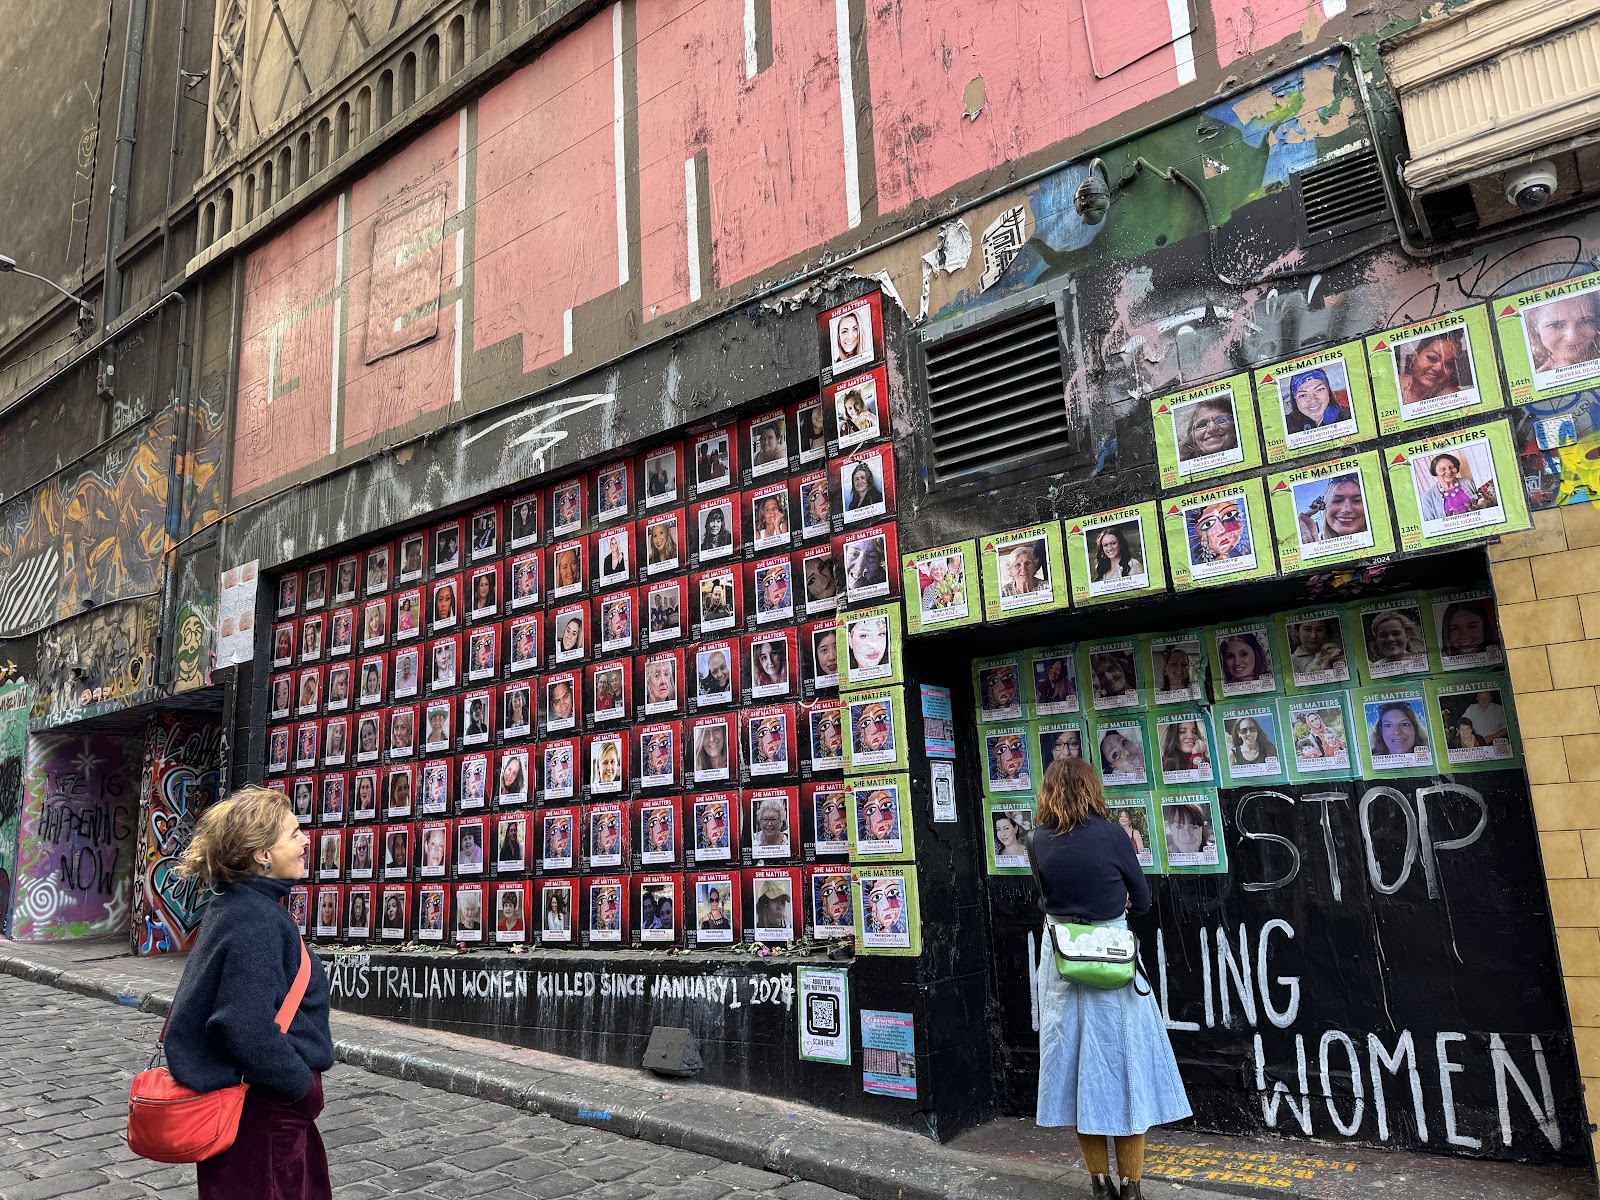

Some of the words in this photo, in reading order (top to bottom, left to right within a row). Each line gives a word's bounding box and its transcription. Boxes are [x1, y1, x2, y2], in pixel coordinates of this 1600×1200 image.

[1518, 293, 1541, 306] SHE
[1545, 279, 1600, 302] MATTERS
[832, 310, 842, 318] SHE
[842, 299, 868, 314] MATTERS
[1389, 331, 1409, 342] SHE
[1412, 314, 1464, 336] MATTERS
[1275, 364, 1294, 376] SHE
[1296, 350, 1343, 369] MATTERS
[1556, 360, 1599, 373] Remembering
[1510, 378, 1530, 388] 14th
[1170, 394, 1186, 406] SHE
[1190, 382, 1232, 400] MATTERS
[1420, 393, 1458, 406] Remembering
[1514, 396, 1534, 404] 2025
[1381, 409, 1398, 418] 12th
[1384, 426, 1400, 434] 2025
[1408, 443, 1429, 455] SHE
[1432, 429, 1487, 450] MATTERS
[1289, 472, 1308, 482] SHE
[1311, 459, 1359, 478] MATTERS
[754, 490, 763, 498] SHE
[764, 484, 786, 494] MATTERS
[1181, 497, 1198, 507] SHE
[1201, 486, 1244, 502] MATTERS
[1082, 518, 1098, 527] SHE
[1100, 508, 1140, 523] MATTERS
[1442, 510, 1481, 522] Remembering
[856, 528, 882, 540] MATTERS
[1401, 524, 1418, 534] 13th
[996, 536, 1008, 544] SHE
[1012, 528, 1046, 541] MATTERS
[1318, 536, 1352, 546] Remembering
[916, 554, 928, 562] SHE
[930, 546, 962, 558] MATTERS
[1282, 548, 1298, 556] 11th
[767, 556, 788, 566] MATTERS
[1372, 556, 1390, 564] 2024
[1284, 564, 1300, 572] 2025
[1360, 604, 1376, 612] SHE
[1378, 598, 1416, 610] MATTERS
[860, 608, 888, 618] MATTERS
[1286, 616, 1300, 624] SHE
[1302, 609, 1338, 622] MATTERS
[1216, 628, 1230, 636] SHE
[1231, 622, 1265, 634] MATTERS
[1166, 634, 1198, 643] MATTERS
[1438, 686, 1454, 694] SHE
[1456, 680, 1498, 692] MATTERS
[862, 690, 891, 700] MATTERS
[1364, 694, 1380, 702] SHE
[1382, 690, 1420, 700] MATTERS
[1304, 699, 1340, 710] MATTERS
[1156, 716, 1169, 724] SHE
[1170, 712, 1202, 722] MATTERS
[1223, 710, 1236, 718] SHE
[1238, 706, 1271, 716] MATTERS
[996, 726, 1024, 736] MATTERS
[1039, 724, 1051, 732] SHE
[1052, 722, 1080, 731] MATTERS
[1097, 722, 1108, 730] SHE
[1110, 720, 1140, 728] MATTERS
[100, 773, 122, 798] IS
[866, 778, 897, 786] MATTERS
[1120, 797, 1145, 805] MATTERS
[1161, 796, 1174, 804] SHE
[1176, 794, 1208, 803] MATTERS
[1002, 802, 1030, 810] MATTERS
[38, 802, 130, 847] HAPPENING
[1235, 783, 1488, 902] STOP
[61, 845, 120, 894] NOW
[330, 965, 456, 998] AUSTRALIAN
[462, 968, 528, 998] WOMEN
[537, 970, 595, 998] KILLED
[601, 972, 646, 998] SINCE
[650, 974, 729, 1004] JANUARY
[730, 980, 742, 1009] 1
[812, 1038, 824, 1046] SCAN
[1253, 1029, 1562, 1151] WOMEN
